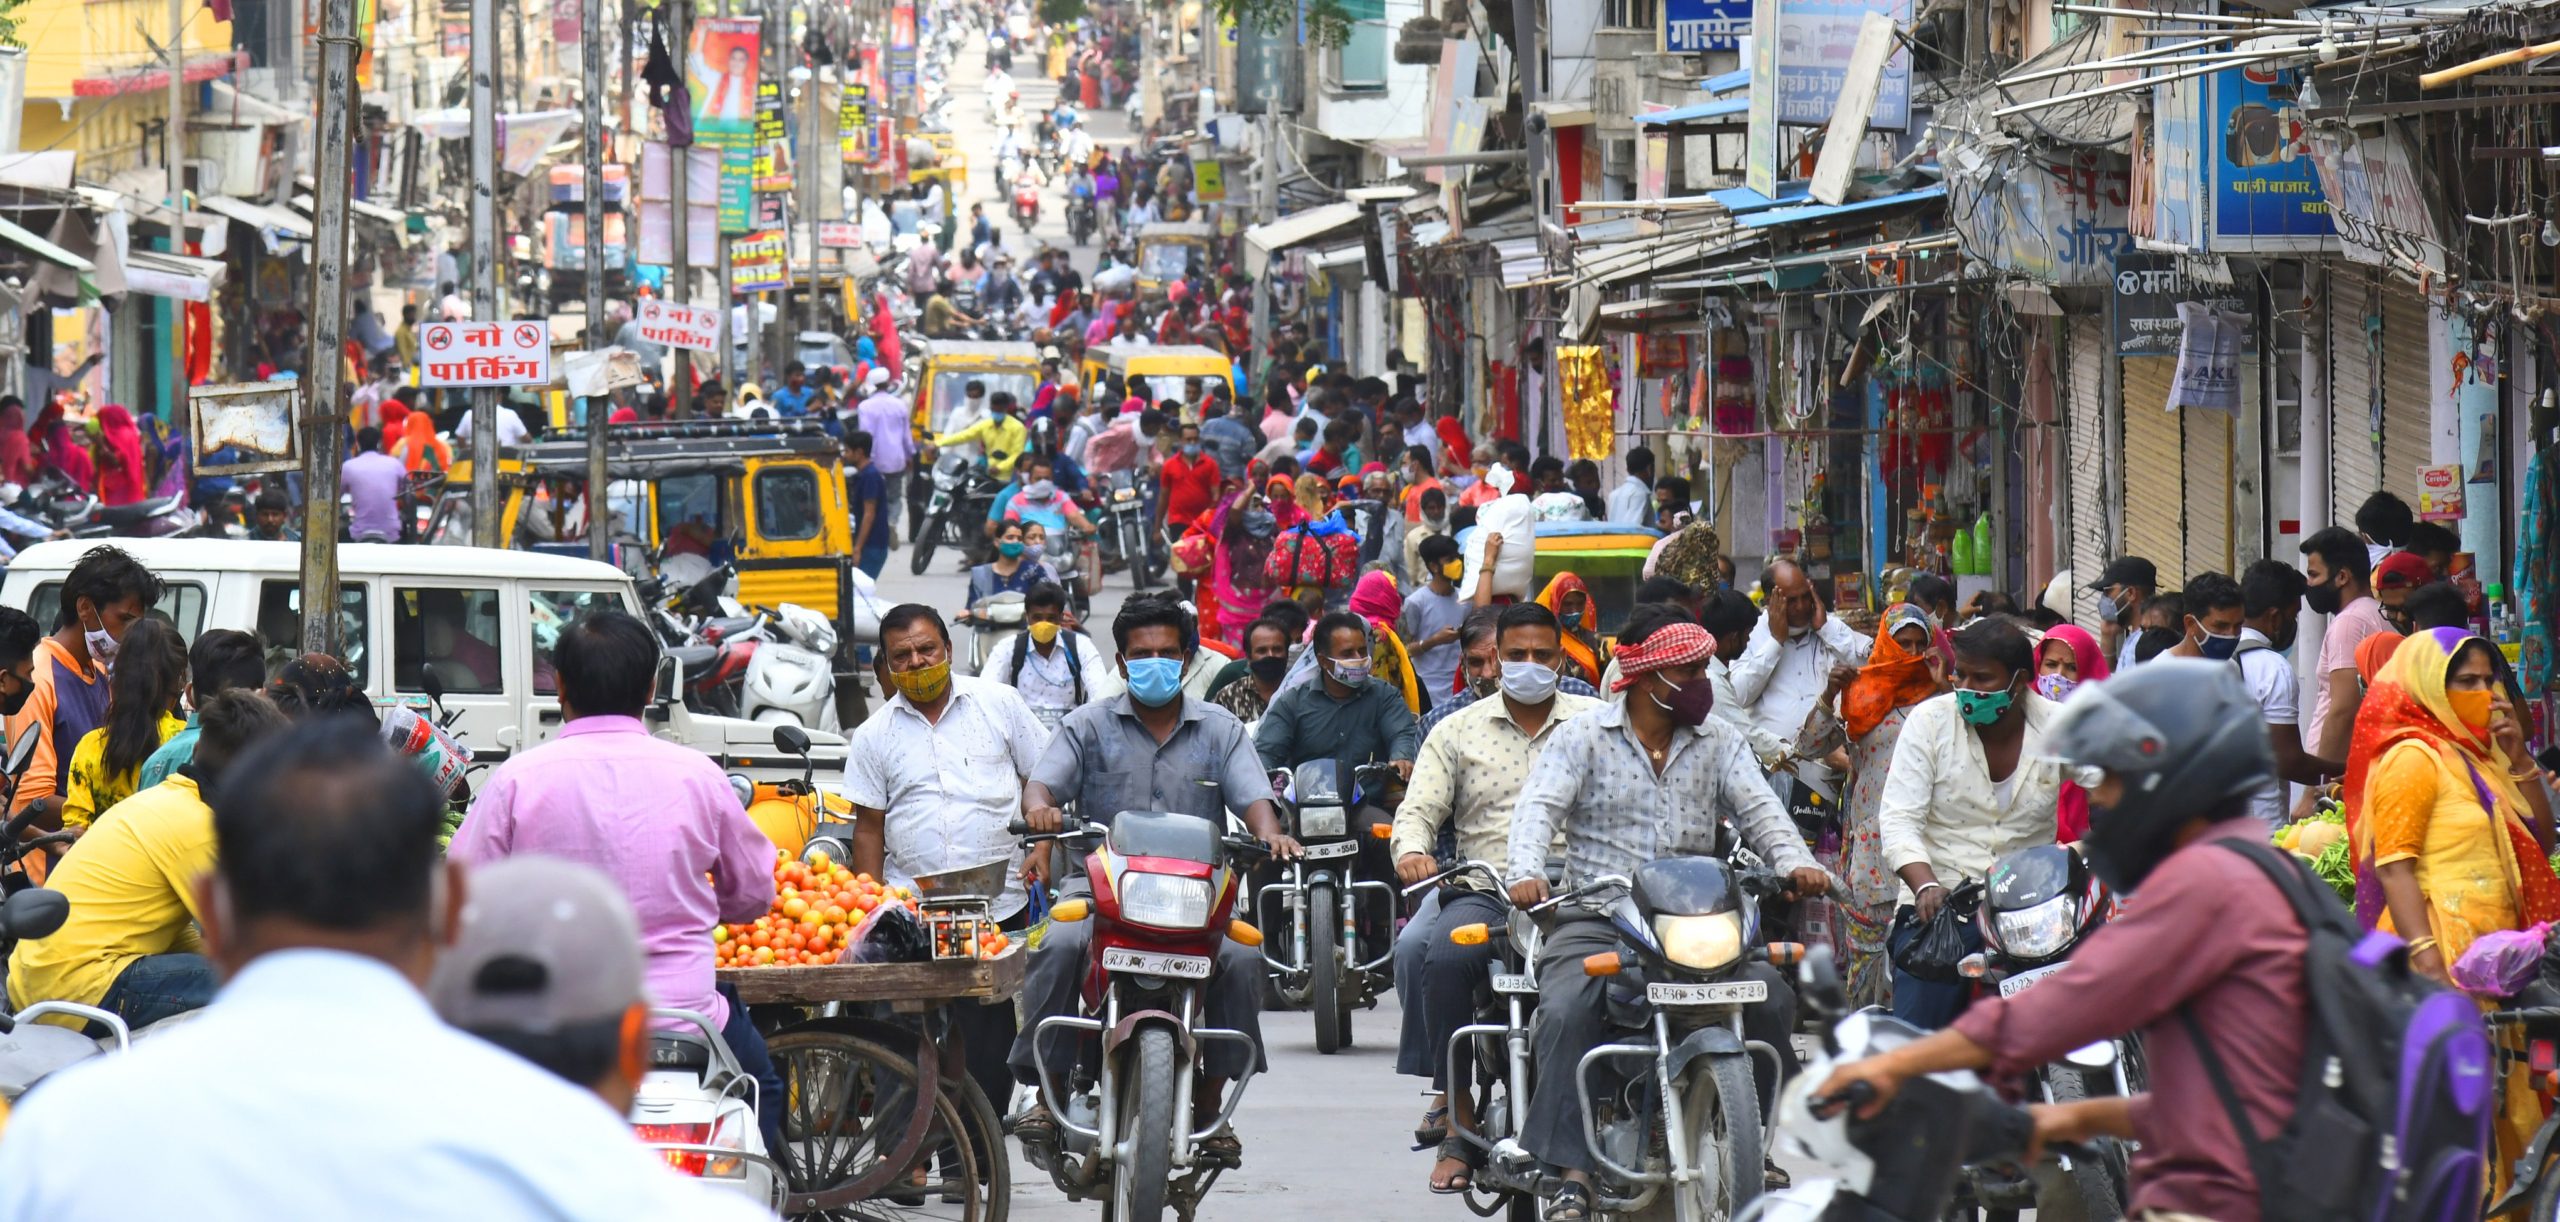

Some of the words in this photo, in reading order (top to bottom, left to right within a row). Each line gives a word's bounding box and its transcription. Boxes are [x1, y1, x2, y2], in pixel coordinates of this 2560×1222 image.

[2233, 178, 2267, 193] पाली
[462, 323, 504, 347] नो
[642, 326, 712, 349] पार्किंग
[428, 355, 540, 381] पार्किंग
[1179, 960, 1207, 975] 9505
[1696, 988, 1717, 1000] SC
[1730, 985, 1765, 999] 8729
